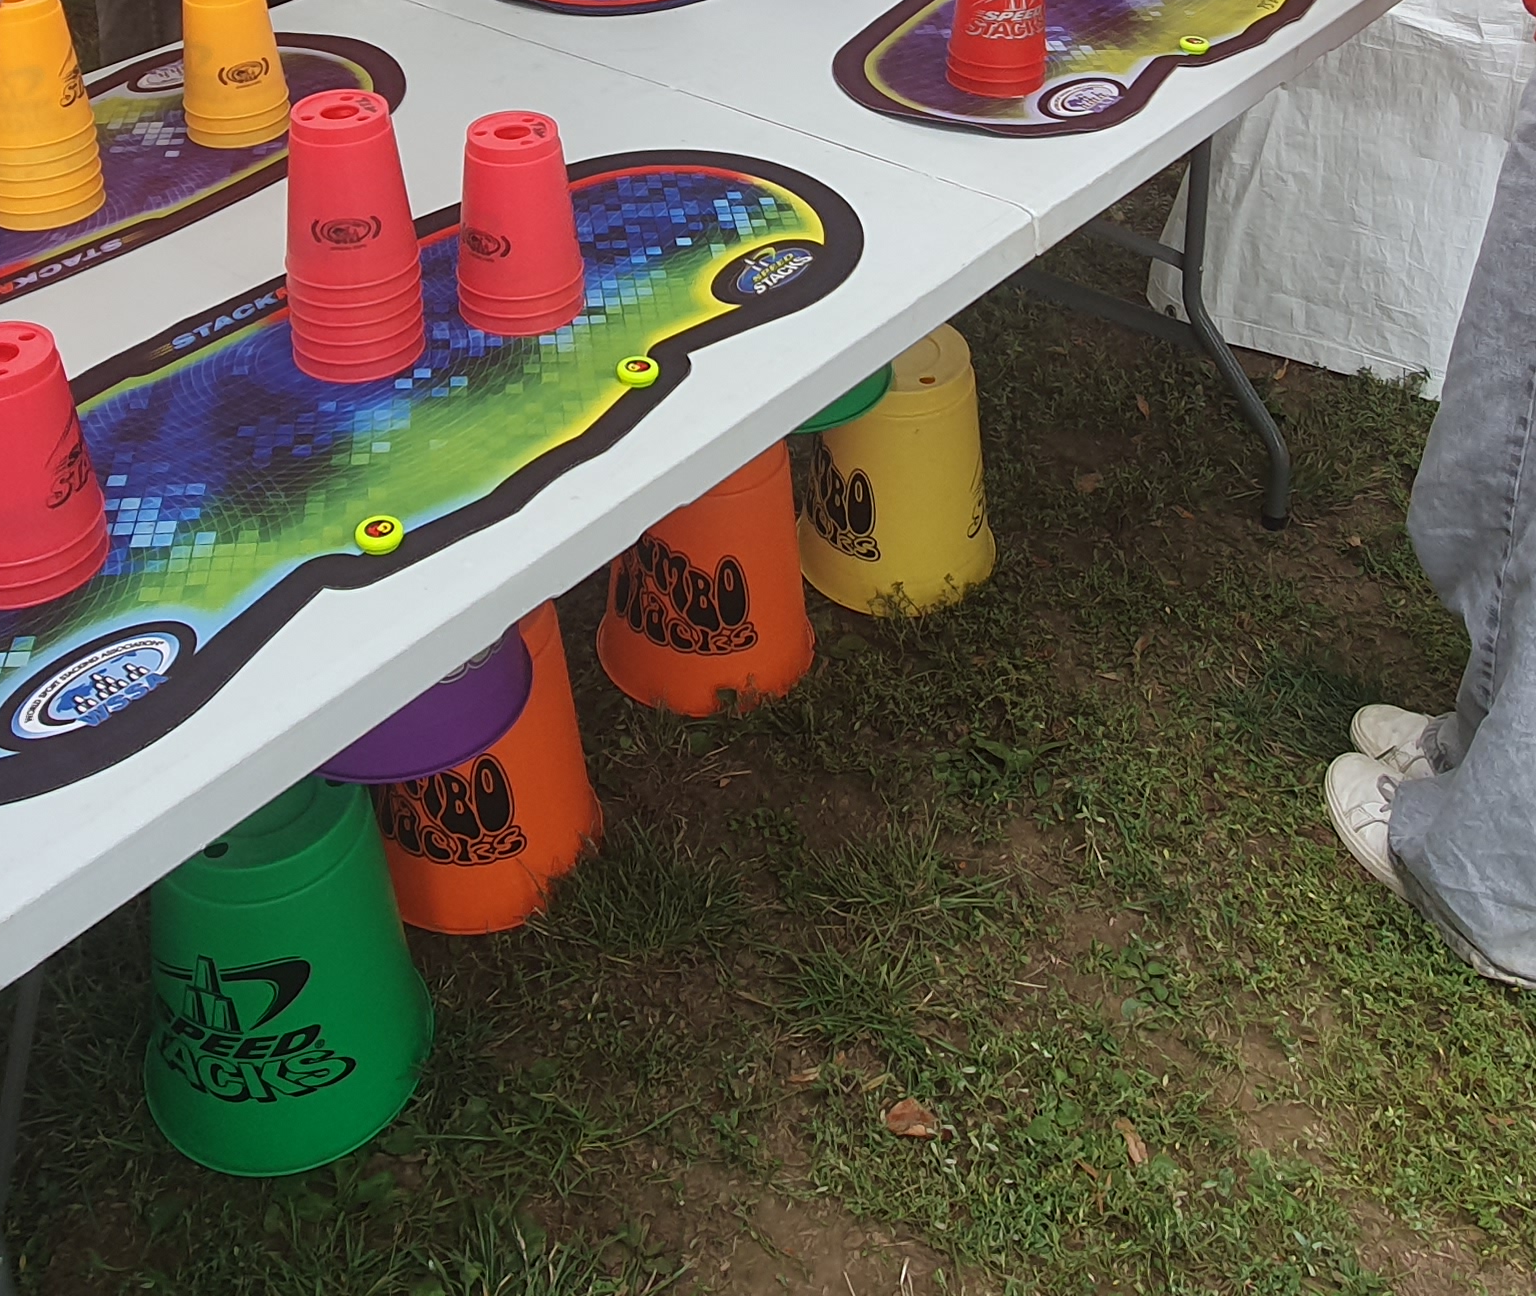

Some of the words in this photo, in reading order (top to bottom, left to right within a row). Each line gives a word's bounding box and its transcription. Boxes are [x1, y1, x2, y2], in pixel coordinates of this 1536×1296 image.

[753, 255, 814, 295] STACKS
[171, 286, 288, 351] STACK
[75, 672, 170, 728] WSSA
[166, 1016, 322, 1059] PEED
[161, 1037, 357, 1103] ACKS
